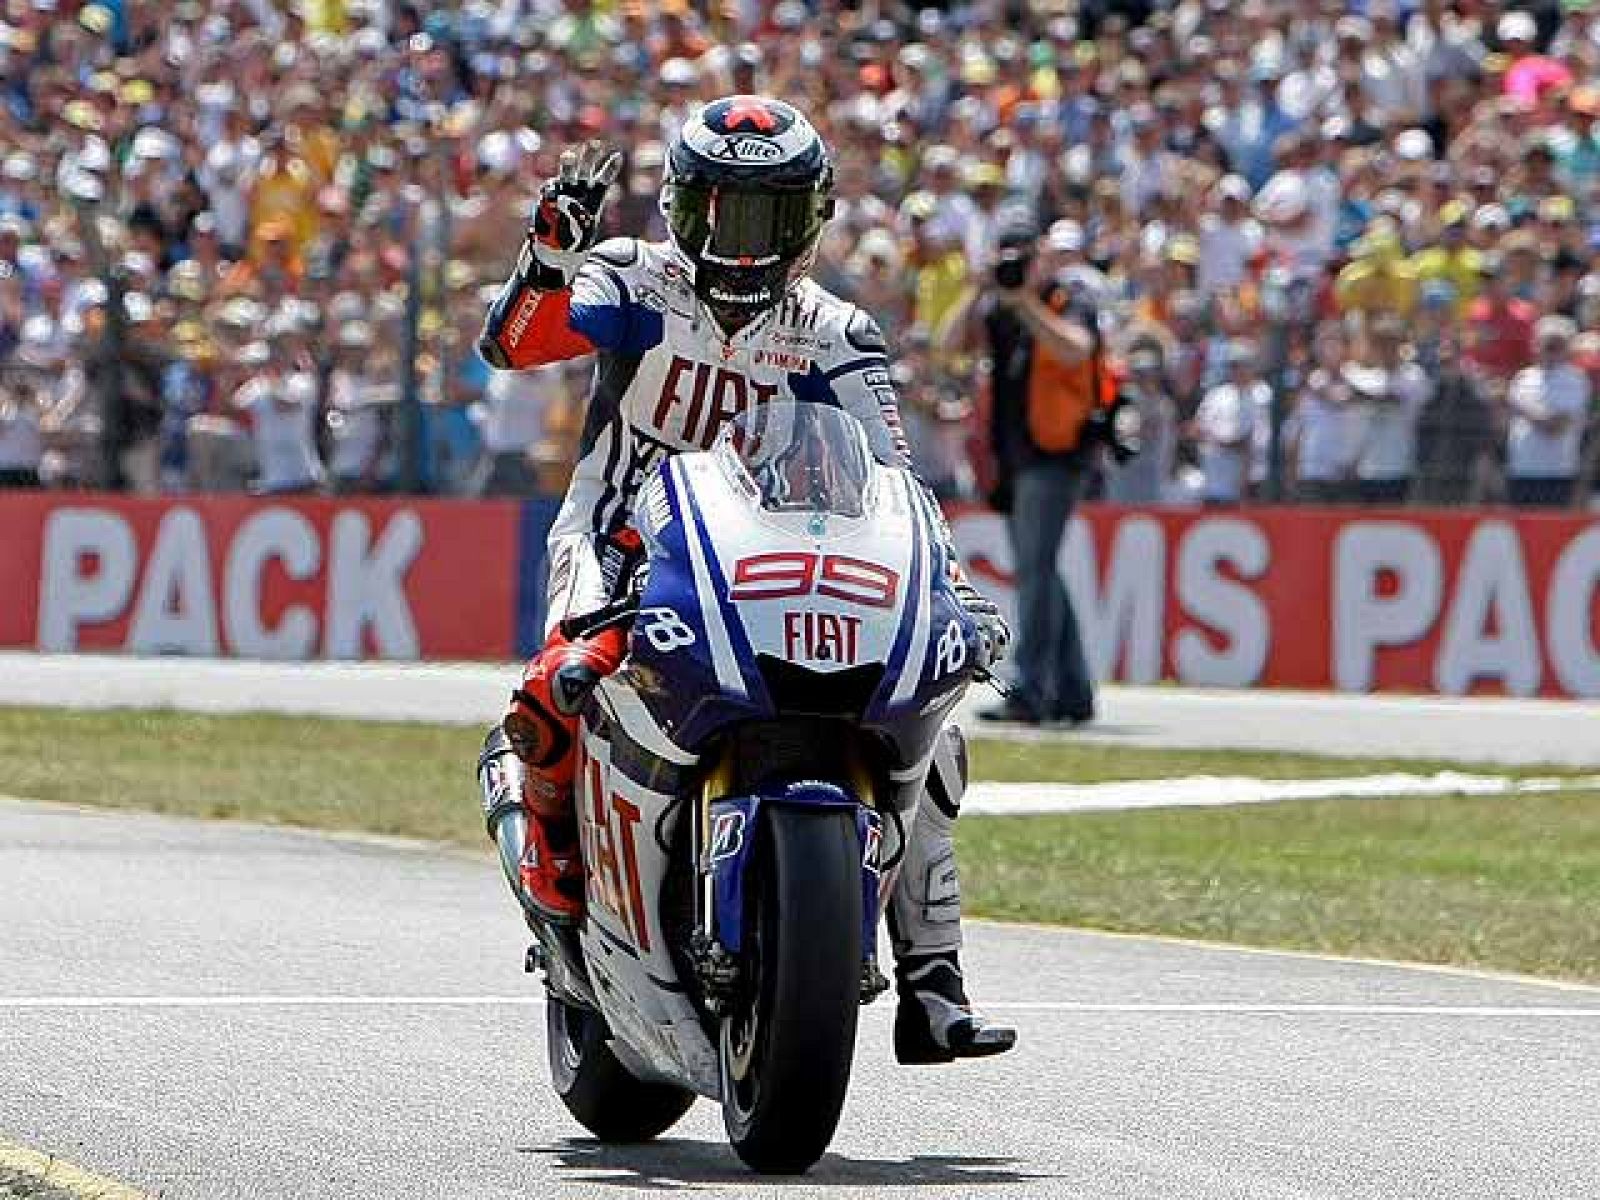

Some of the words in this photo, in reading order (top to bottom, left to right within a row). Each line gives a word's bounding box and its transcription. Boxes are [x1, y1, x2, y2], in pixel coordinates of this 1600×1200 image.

[654, 354, 778, 456] FIAT
[38, 505, 426, 660] PACK
[730, 552, 901, 609] 99
[784, 611, 861, 664] FIAT
[577, 745, 652, 955] IAT
